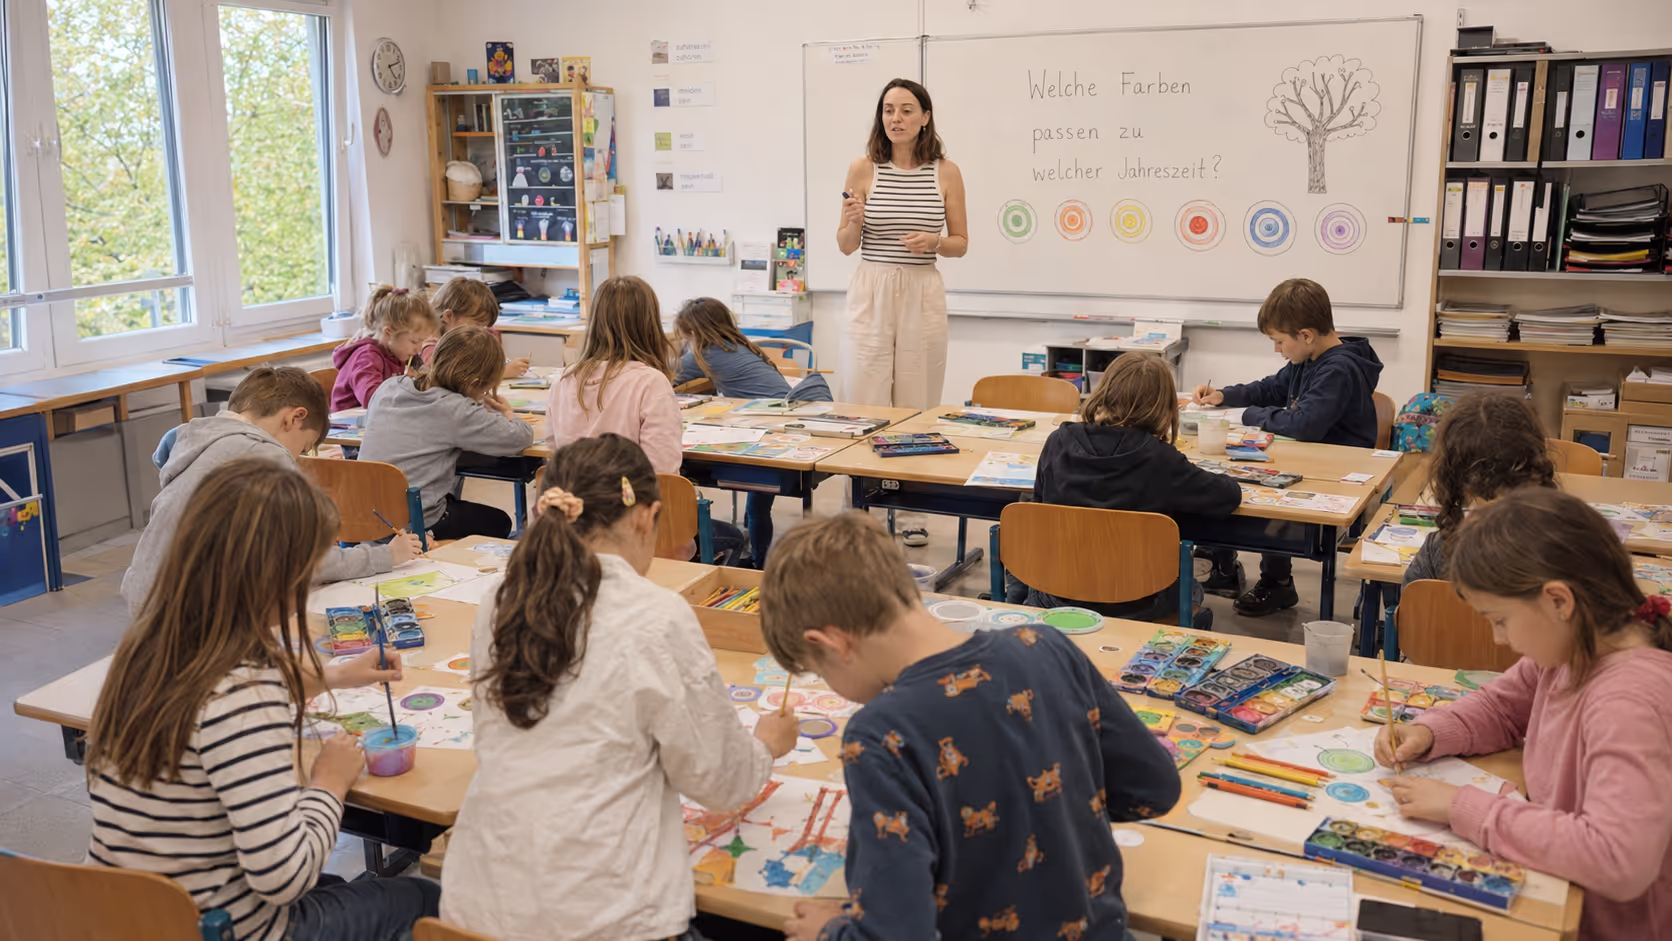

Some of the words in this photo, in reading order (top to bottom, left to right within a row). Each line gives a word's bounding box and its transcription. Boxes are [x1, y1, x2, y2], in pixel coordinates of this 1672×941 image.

[1028, 69, 1098, 100] Welche
[1122, 71, 1191, 96] Farben
[1033, 127, 1099, 154] passen
[1119, 126, 1144, 139] zu
[1033, 157, 1103, 182] welcher
[1117, 154, 1222, 180] Jahreszeit?
